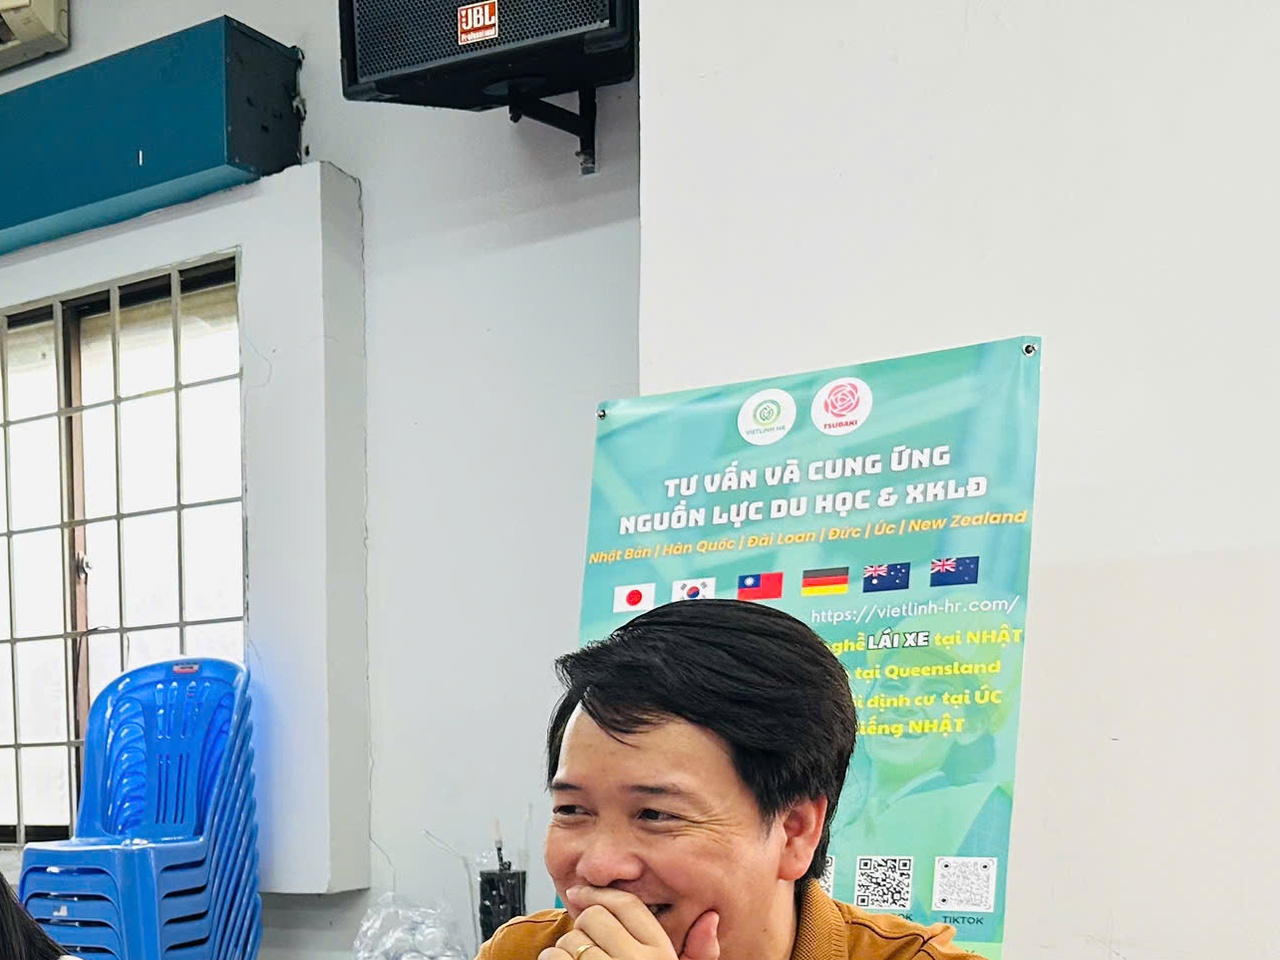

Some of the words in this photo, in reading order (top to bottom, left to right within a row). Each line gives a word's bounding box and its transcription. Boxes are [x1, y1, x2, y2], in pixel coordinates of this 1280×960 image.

[461, 5, 496, 30] JBL
[823, 419, 858, 430] TSUBAKI
[665, 473, 702, 499] TƯ
[704, 460, 757, 493] VẤN
[765, 457, 800, 487] VÀ
[808, 453, 883, 482] CUNG
[891, 444, 951, 472] ỨNG
[619, 500, 705, 535] NGUỒN
[712, 500, 763, 528] LỰC
[770, 497, 808, 519] DU
[814, 489, 871, 518] HỌC
[877, 487, 898, 508] &
[905, 476, 988, 504] XKLĐ
[588, 551, 622, 565] Nhật
[624, 547, 651, 560] Bản
[662, 540, 693, 556] Hàn
[696, 537, 736, 554] Quốc
[747, 535, 774, 548] Đài
[777, 531, 816, 545] Loan
[828, 525, 862, 540] Đức
[874, 519, 896, 535] Úc
[908, 516, 946, 532] New
[949, 510, 1028, 528] Zealand
[811, 595, 1021, 626] https://vietlinh-hr.com/
[867, 627, 900, 650] LÁI
[903, 630, 930, 648] XE
[933, 629, 962, 649] tại
[966, 623, 1022, 647] NHẬT
[854, 664, 881, 683] tại
[884, 660, 1002, 680] Queensland
[866, 692, 911, 711] định
[914, 692, 937, 706] cư
[942, 689, 971, 708] tại
[974, 684, 1003, 705] ÚC
[908, 712, 966, 736] NHẬT
[941, 914, 984, 926] TIKTOK
